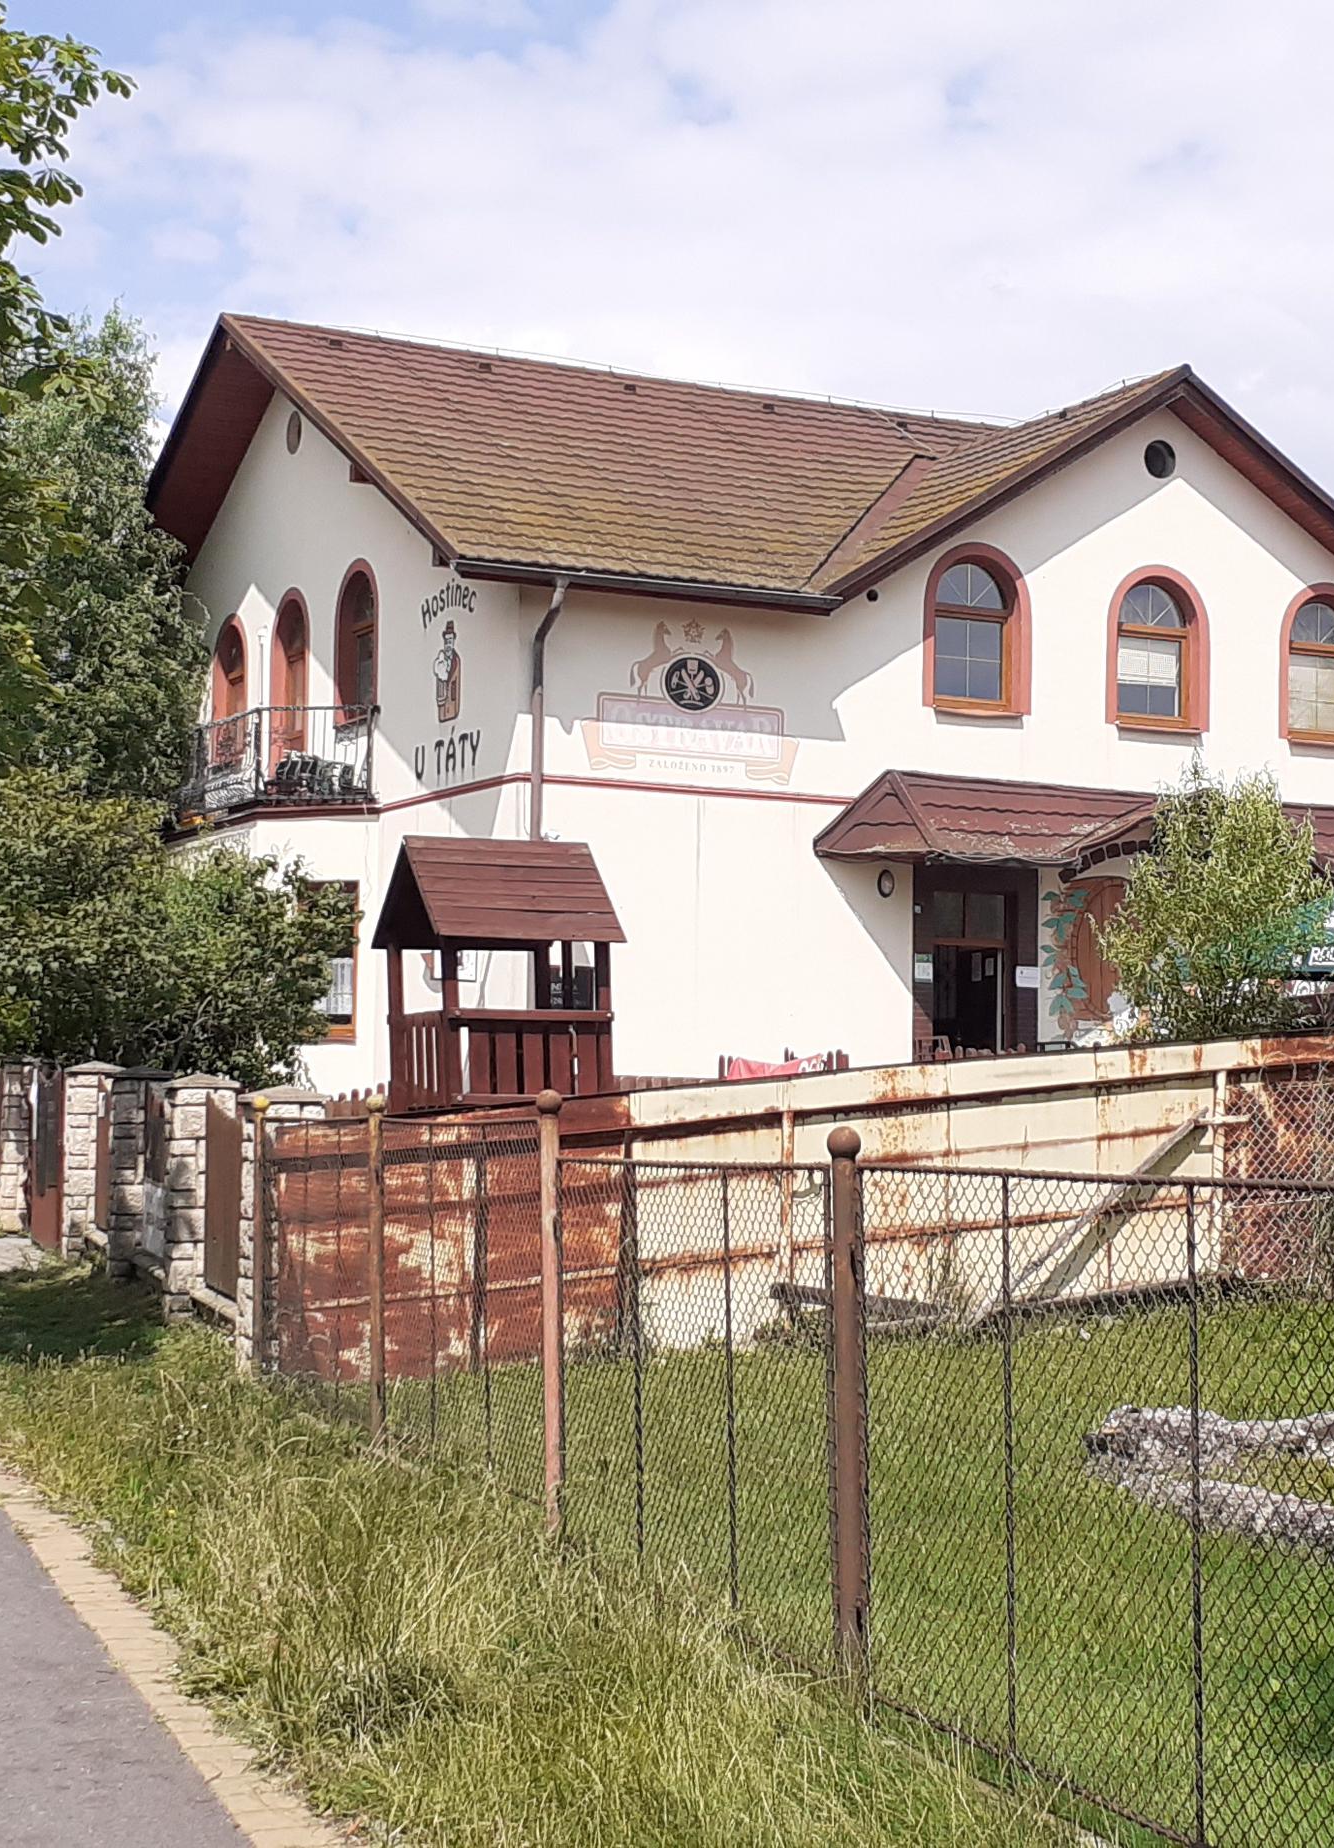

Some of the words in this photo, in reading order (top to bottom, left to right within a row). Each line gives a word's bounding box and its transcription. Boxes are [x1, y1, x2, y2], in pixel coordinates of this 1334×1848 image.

[421, 578, 478, 629] Hostinec
[414, 745, 426, 780] U
[433, 726, 481, 776] TÁTY
[648, 758, 707, 772] ZALOŽENO
